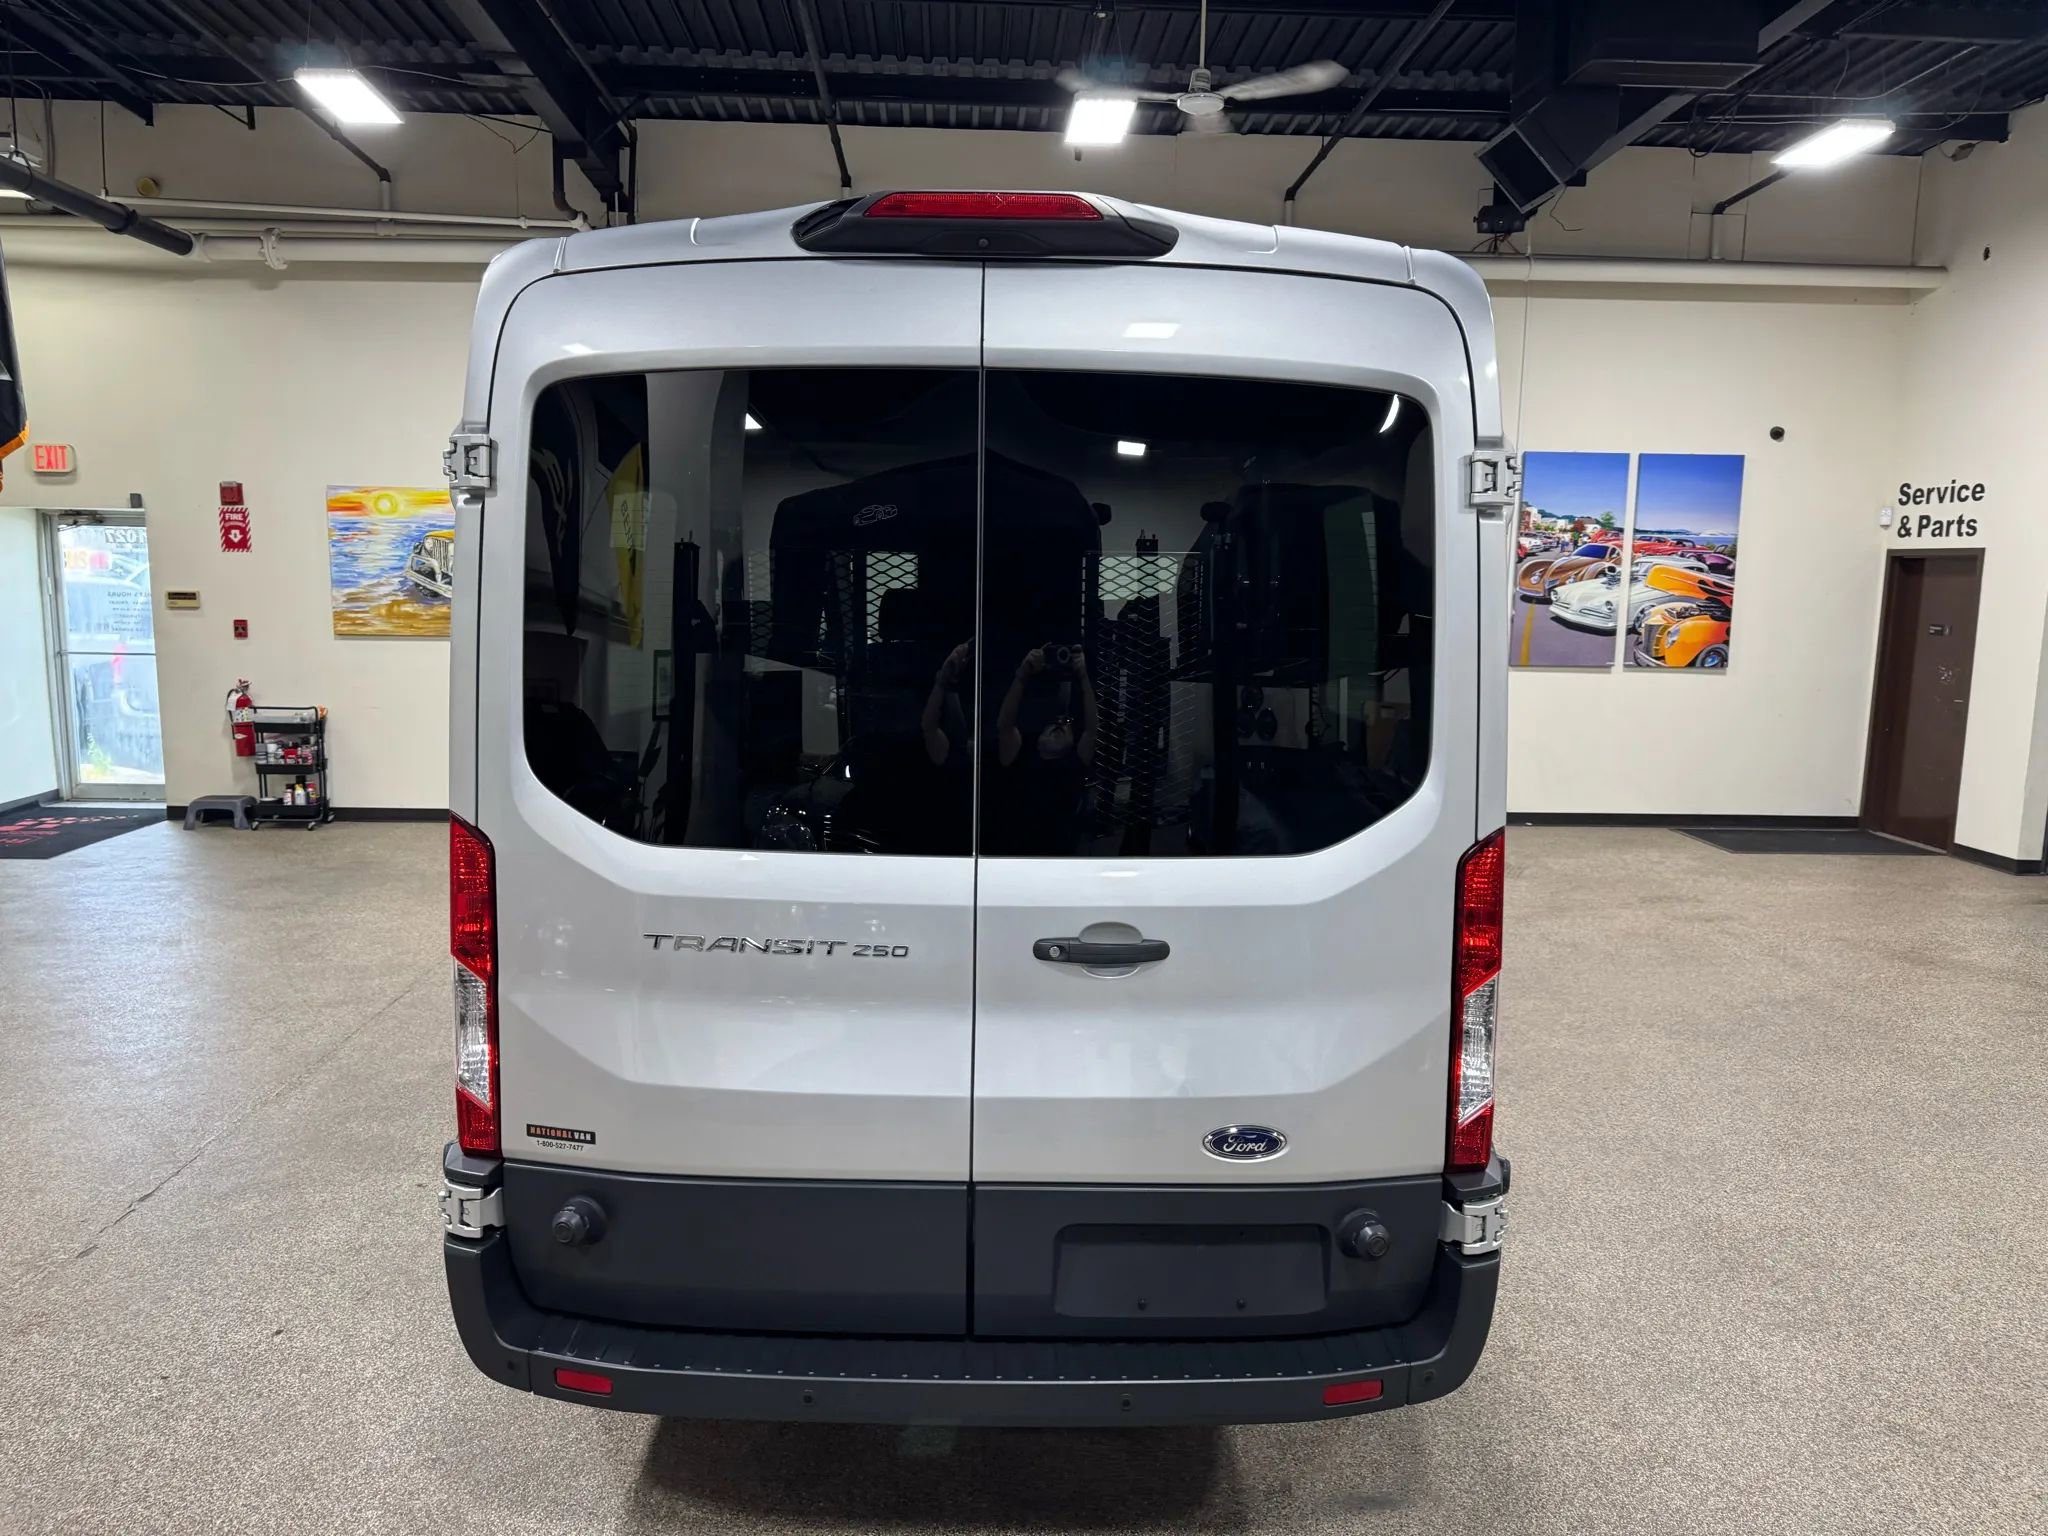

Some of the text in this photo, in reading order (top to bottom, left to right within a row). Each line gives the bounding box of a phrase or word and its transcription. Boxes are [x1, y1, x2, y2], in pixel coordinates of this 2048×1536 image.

[34, 445, 67, 470] EXIT
[1898, 479, 1985, 506] Service
[225, 513, 244, 521] FIRE
[1897, 513, 1978, 538] & Parts
[643, 932, 909, 958] TRANSIT 250
[530, 1126, 592, 1141] NATIONAL VAN
[1223, 1134, 1268, 1152] Ford
[536, 1140, 584, 1151] 1-800-527-7477
